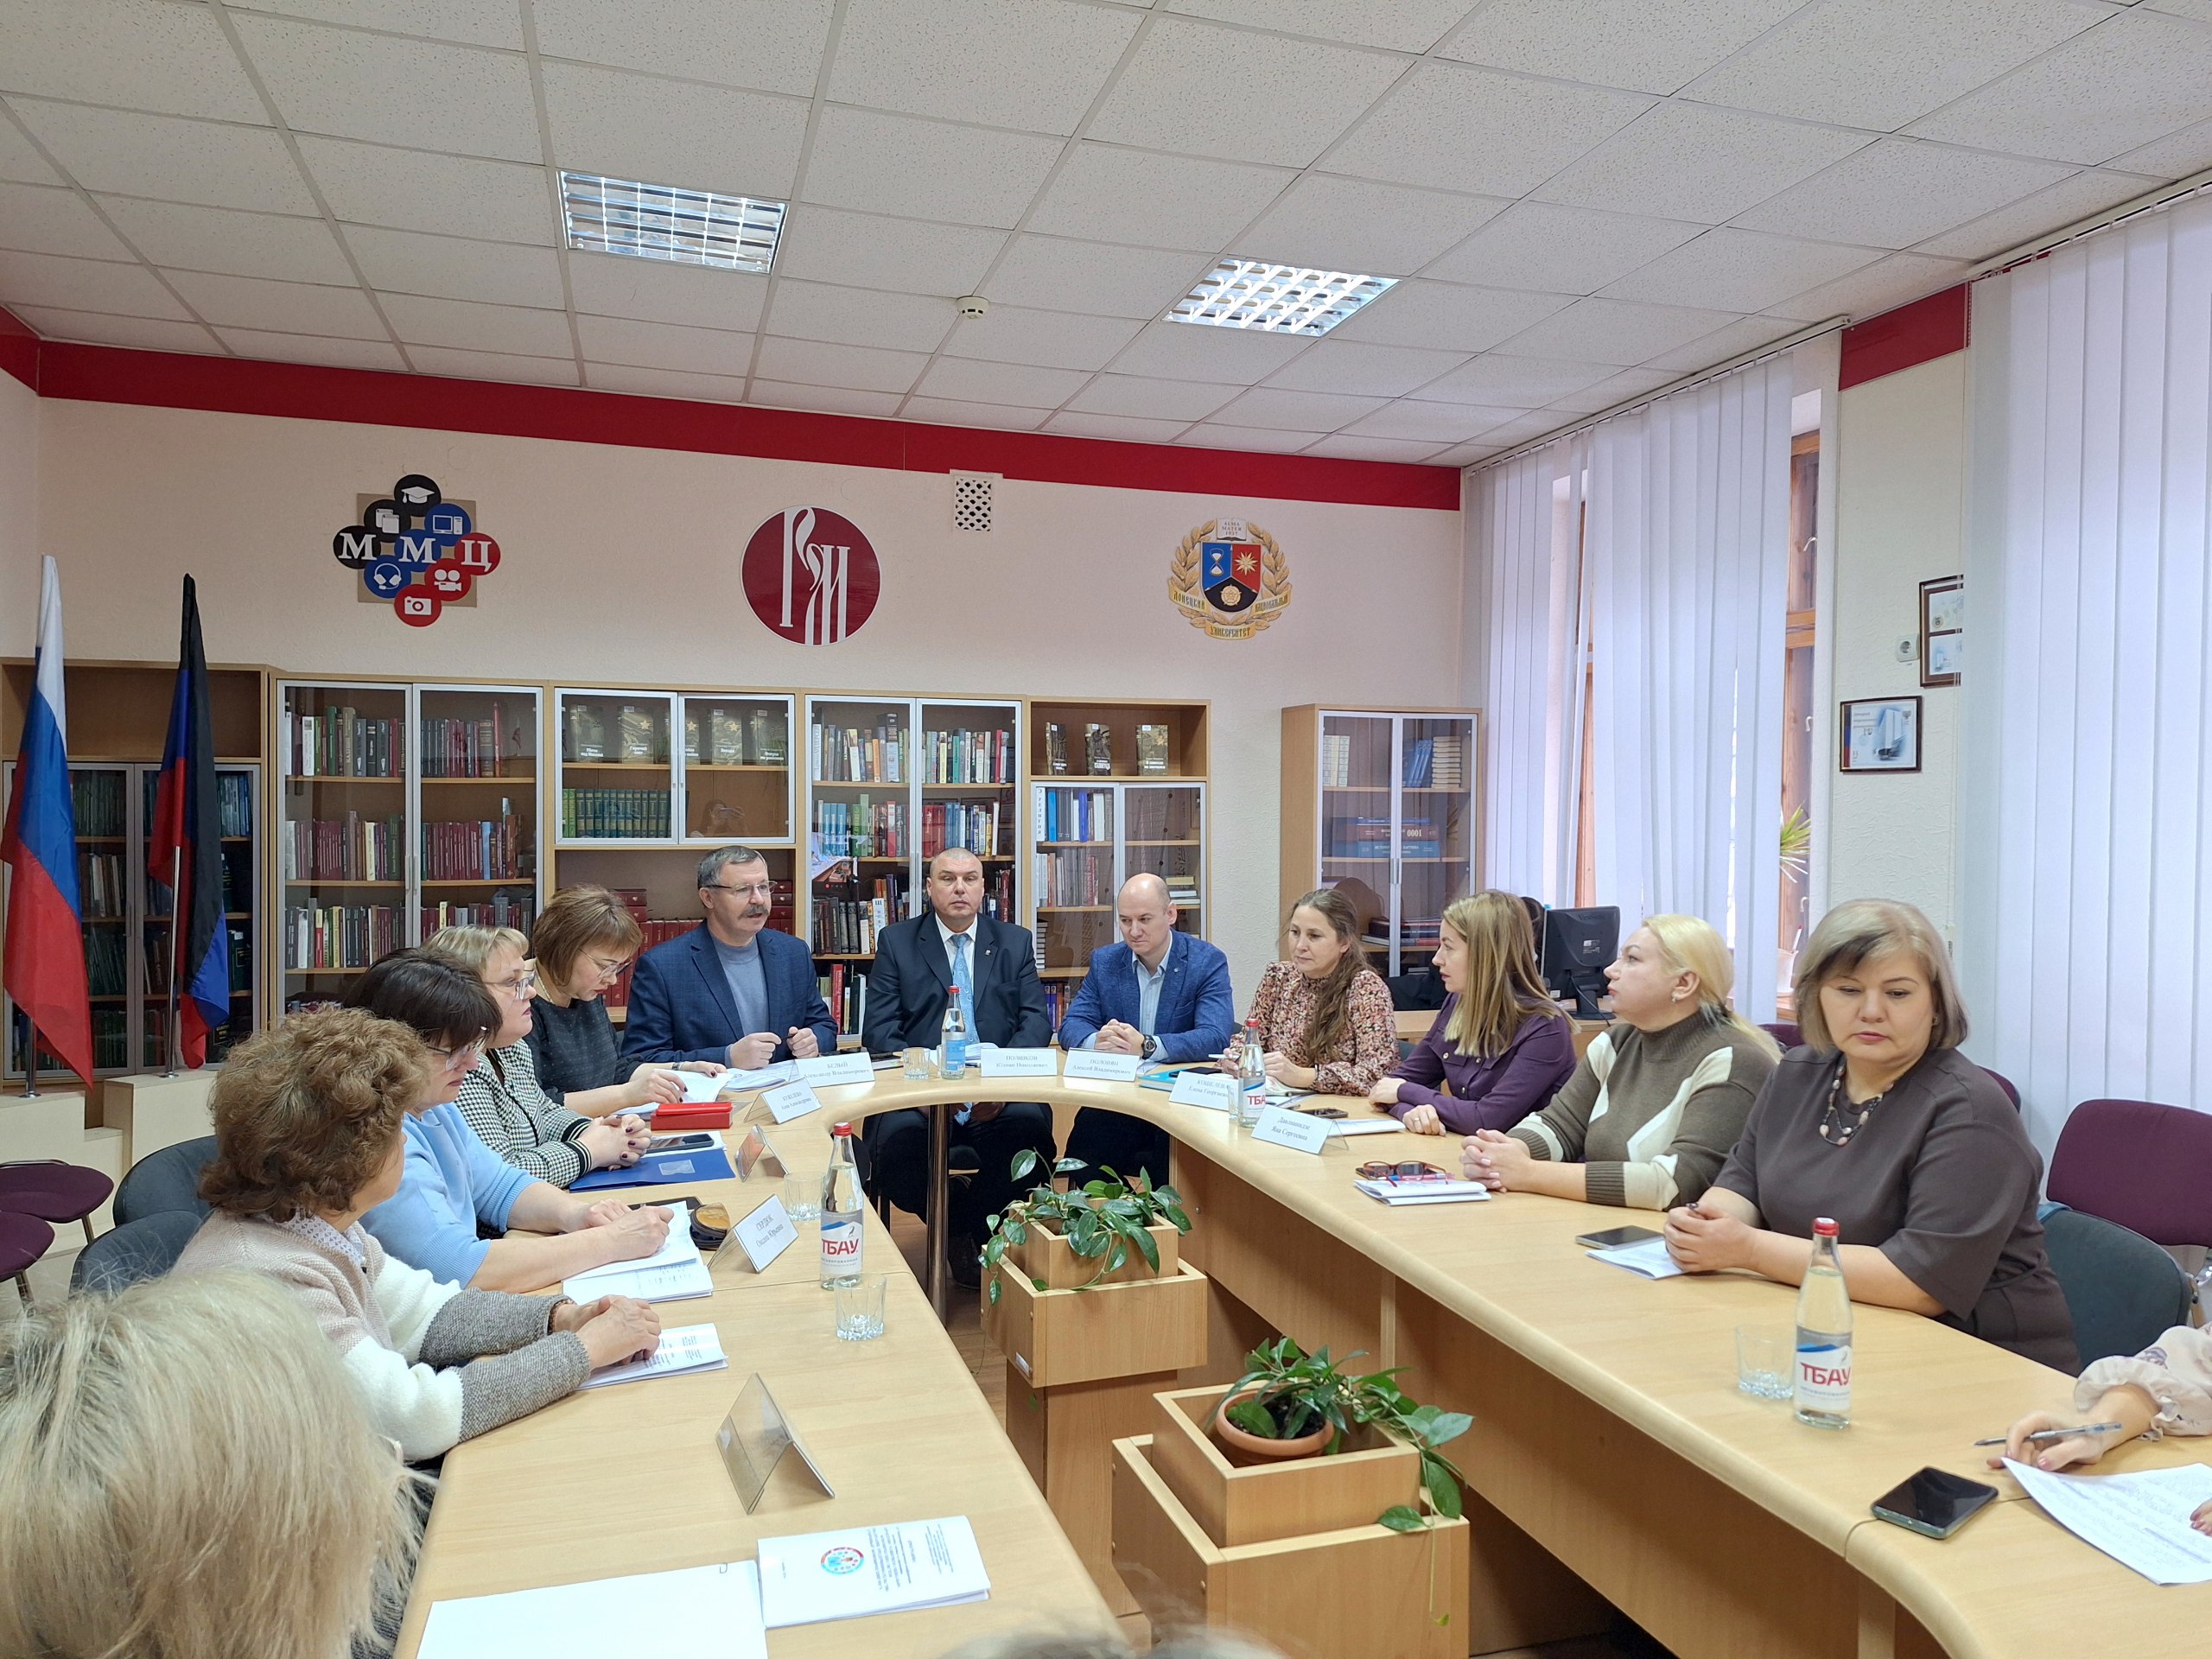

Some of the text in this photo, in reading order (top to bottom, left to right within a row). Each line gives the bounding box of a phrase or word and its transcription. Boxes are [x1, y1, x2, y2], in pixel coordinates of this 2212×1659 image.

[1210, 626, 1251, 637] УНИВЕРСИТЕТ
[1246, 1095, 1267, 1105] ТБА
[1281, 1128, 1308, 1141] Сергеевна
[821, 1237, 859, 1255] ТБАУ
[1800, 1361, 1851, 1386] ТБАУ
